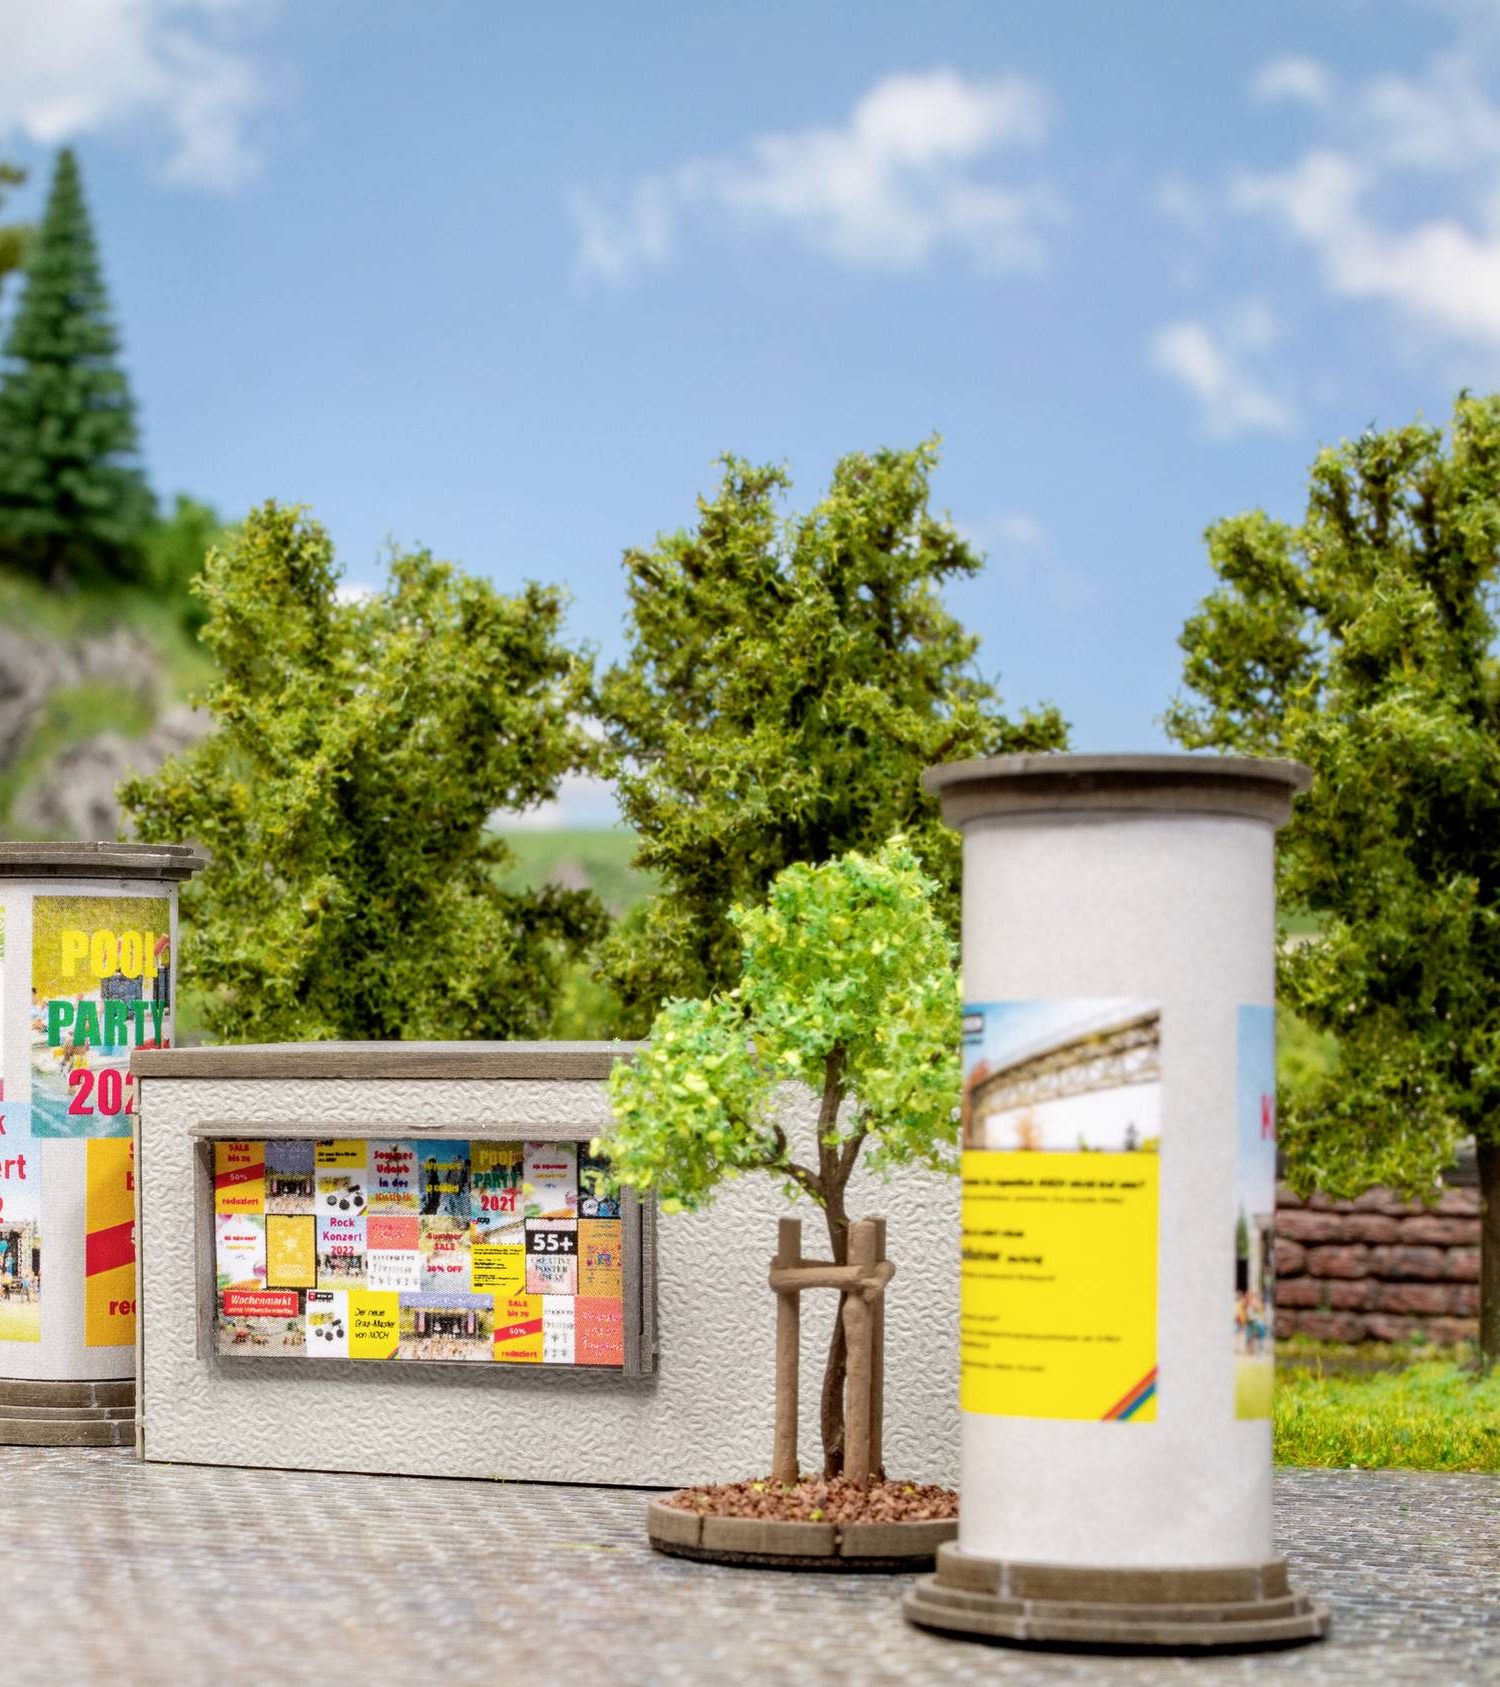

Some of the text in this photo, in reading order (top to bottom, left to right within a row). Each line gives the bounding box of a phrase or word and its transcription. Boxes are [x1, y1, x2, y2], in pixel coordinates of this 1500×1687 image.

[62, 929, 158, 979] POOL
[48, 1000, 164, 1047] PARTY
[374, 1150, 413, 1160] Sommer
[376, 1164, 410, 1173] Urlaub
[473, 1171, 520, 1189] PARTY
[481, 1195, 516, 1212] 2021
[330, 1217, 355, 1227] Rock
[323, 1231, 362, 1242] Konzert
[434, 1242, 456, 1251] SALE
[533, 1233, 574, 1252] 55+
[330, 1245, 354, 1256] 2022
[447, 1265, 463, 1273] OFF
[231, 1295, 292, 1306] Wochenmarkt
[508, 1300, 528, 1308] SALE
[355, 1307, 386, 1317] Der neue
[355, 1319, 395, 1329] Gras-Master
[355, 1330, 389, 1340] von NOCH
[509, 1328, 526, 1336] 50%
[501, 1350, 537, 1359] reduziert
